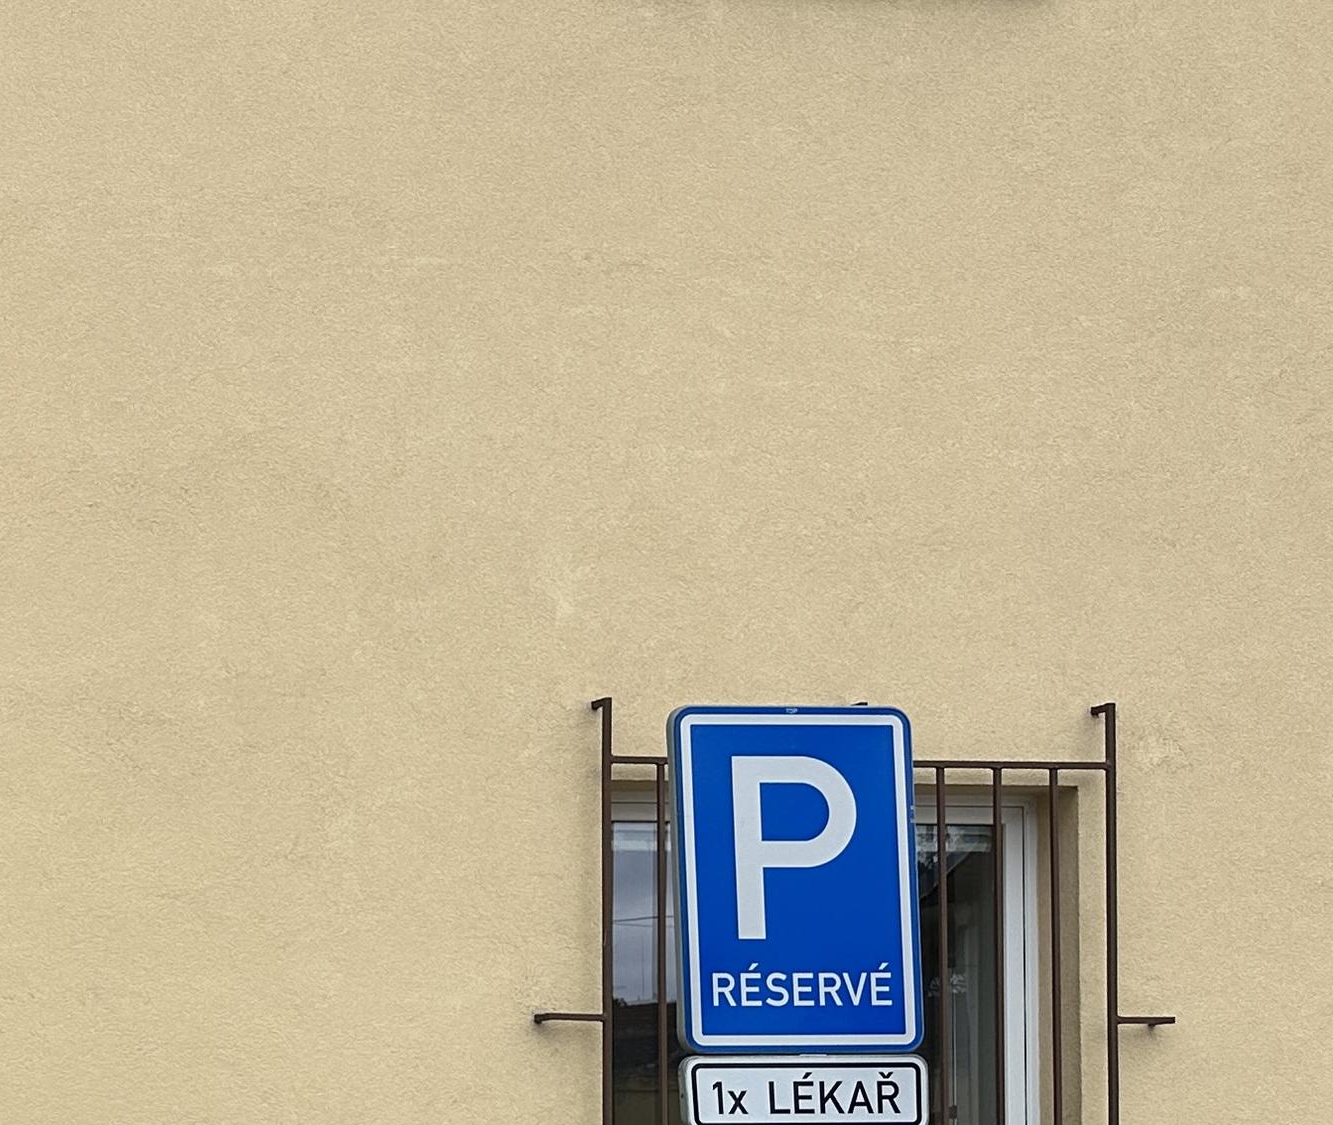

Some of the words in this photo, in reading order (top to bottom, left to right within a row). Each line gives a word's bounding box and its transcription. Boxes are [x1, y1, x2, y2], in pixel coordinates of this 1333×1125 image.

[731, 755, 858, 940] P
[712, 962, 893, 1007] RÉSERVÉ
[712, 1081, 749, 1115] 1x
[768, 1071, 901, 1115] LÉKAŘ
